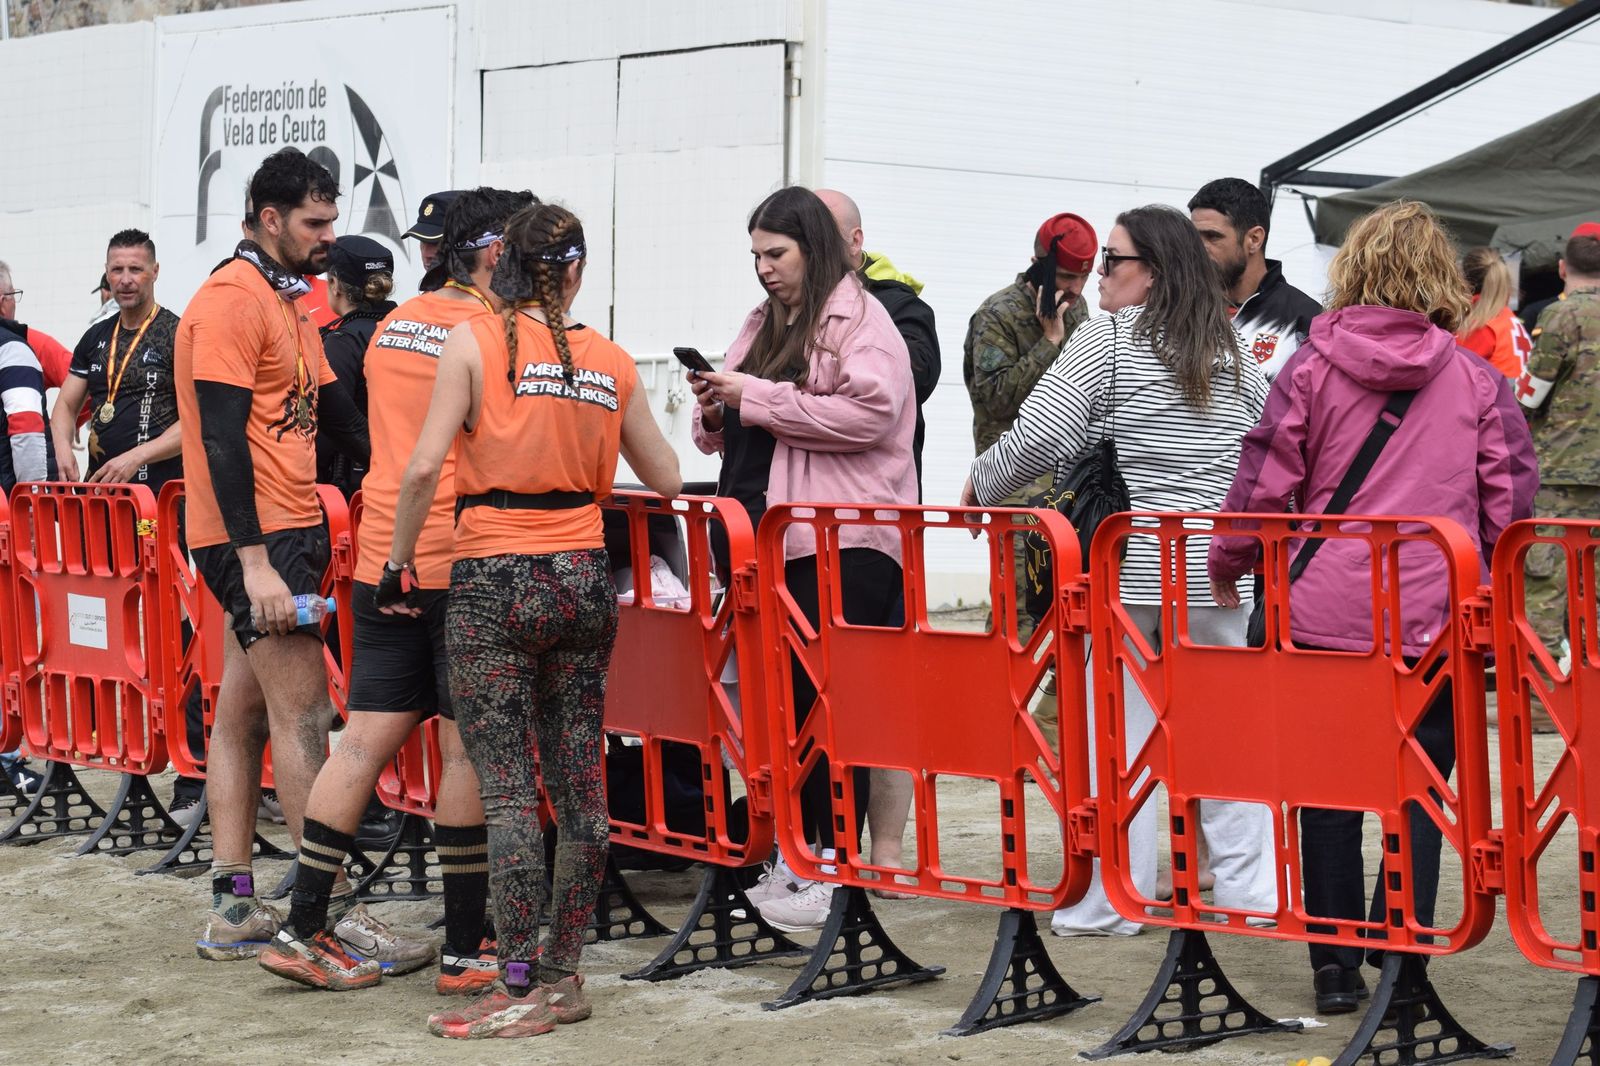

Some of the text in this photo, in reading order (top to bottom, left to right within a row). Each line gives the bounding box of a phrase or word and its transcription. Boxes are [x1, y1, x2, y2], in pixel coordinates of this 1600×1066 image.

[223, 78, 326, 114] Federación de
[223, 113, 326, 147] Vela de Ceuta
[385, 319, 449, 341] MERY JAN
[376, 334, 443, 357] PETER PARKE
[516, 380, 562, 395] PETER
[523, 362, 616, 392] MER JANE
